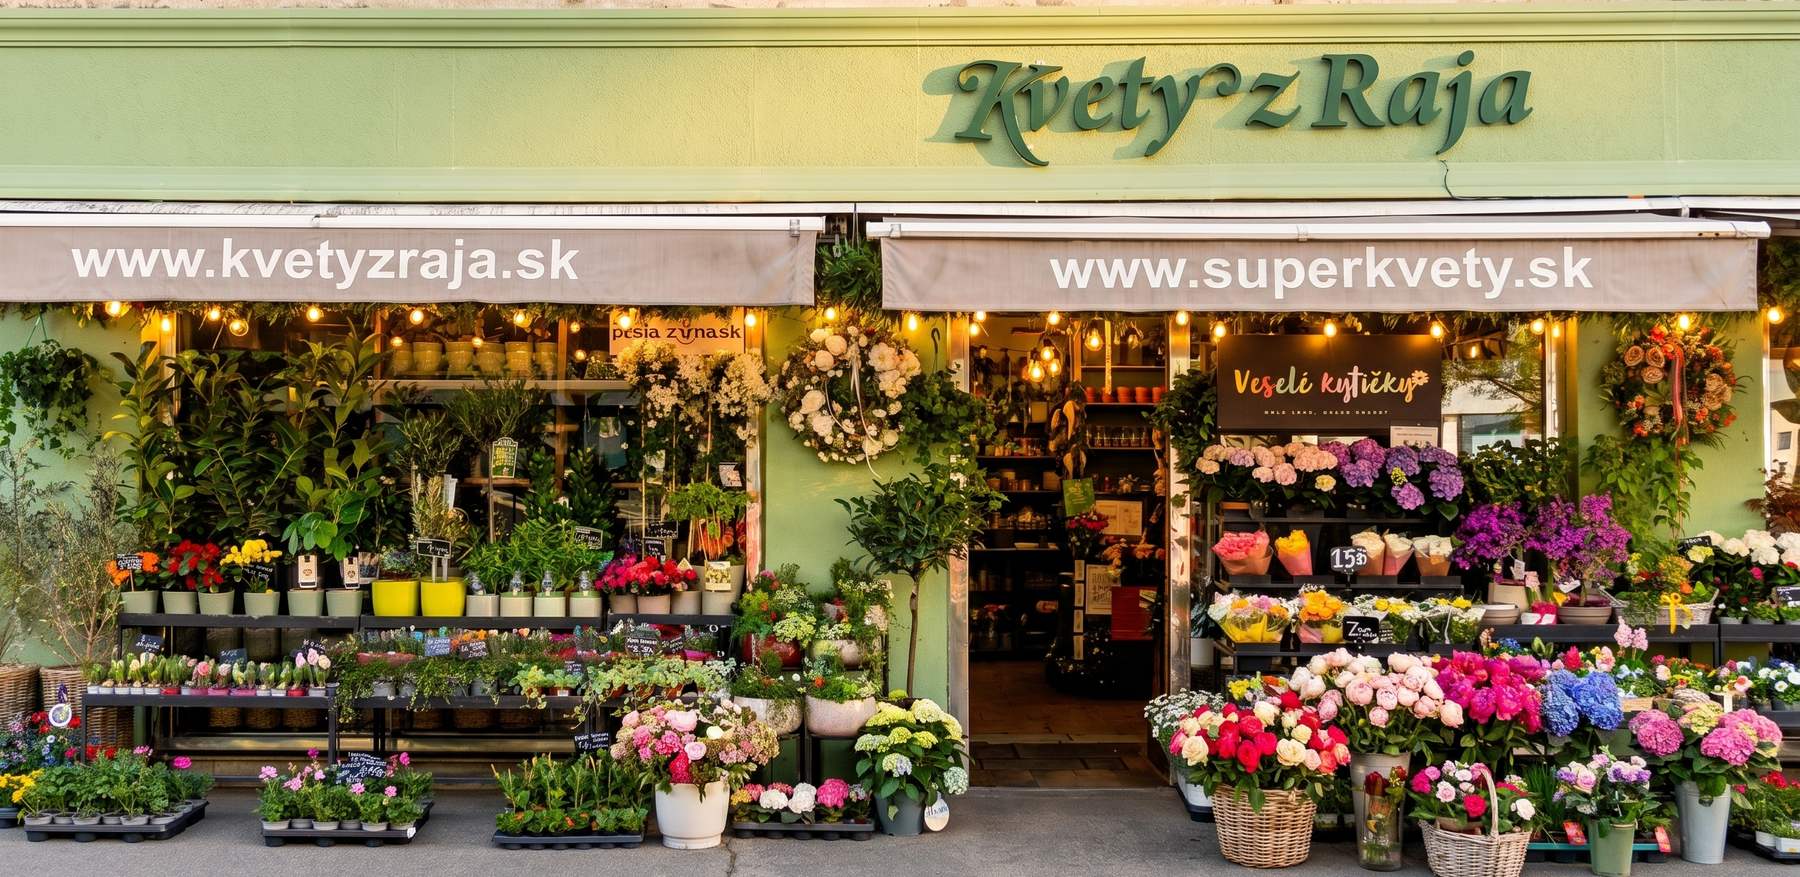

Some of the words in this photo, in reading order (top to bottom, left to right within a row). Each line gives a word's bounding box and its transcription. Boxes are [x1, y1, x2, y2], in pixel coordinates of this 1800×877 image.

[955, 56, 1241, 167] Kvety
[1245, 70, 1302, 128] z
[1311, 49, 1533, 156] Raja
[71, 237, 579, 290] www.kvetyzraja.sk
[1049, 246, 1593, 300] www.superkvety.sk
[1234, 365, 1312, 398] Veselé
[1321, 365, 1418, 403] kytičky
